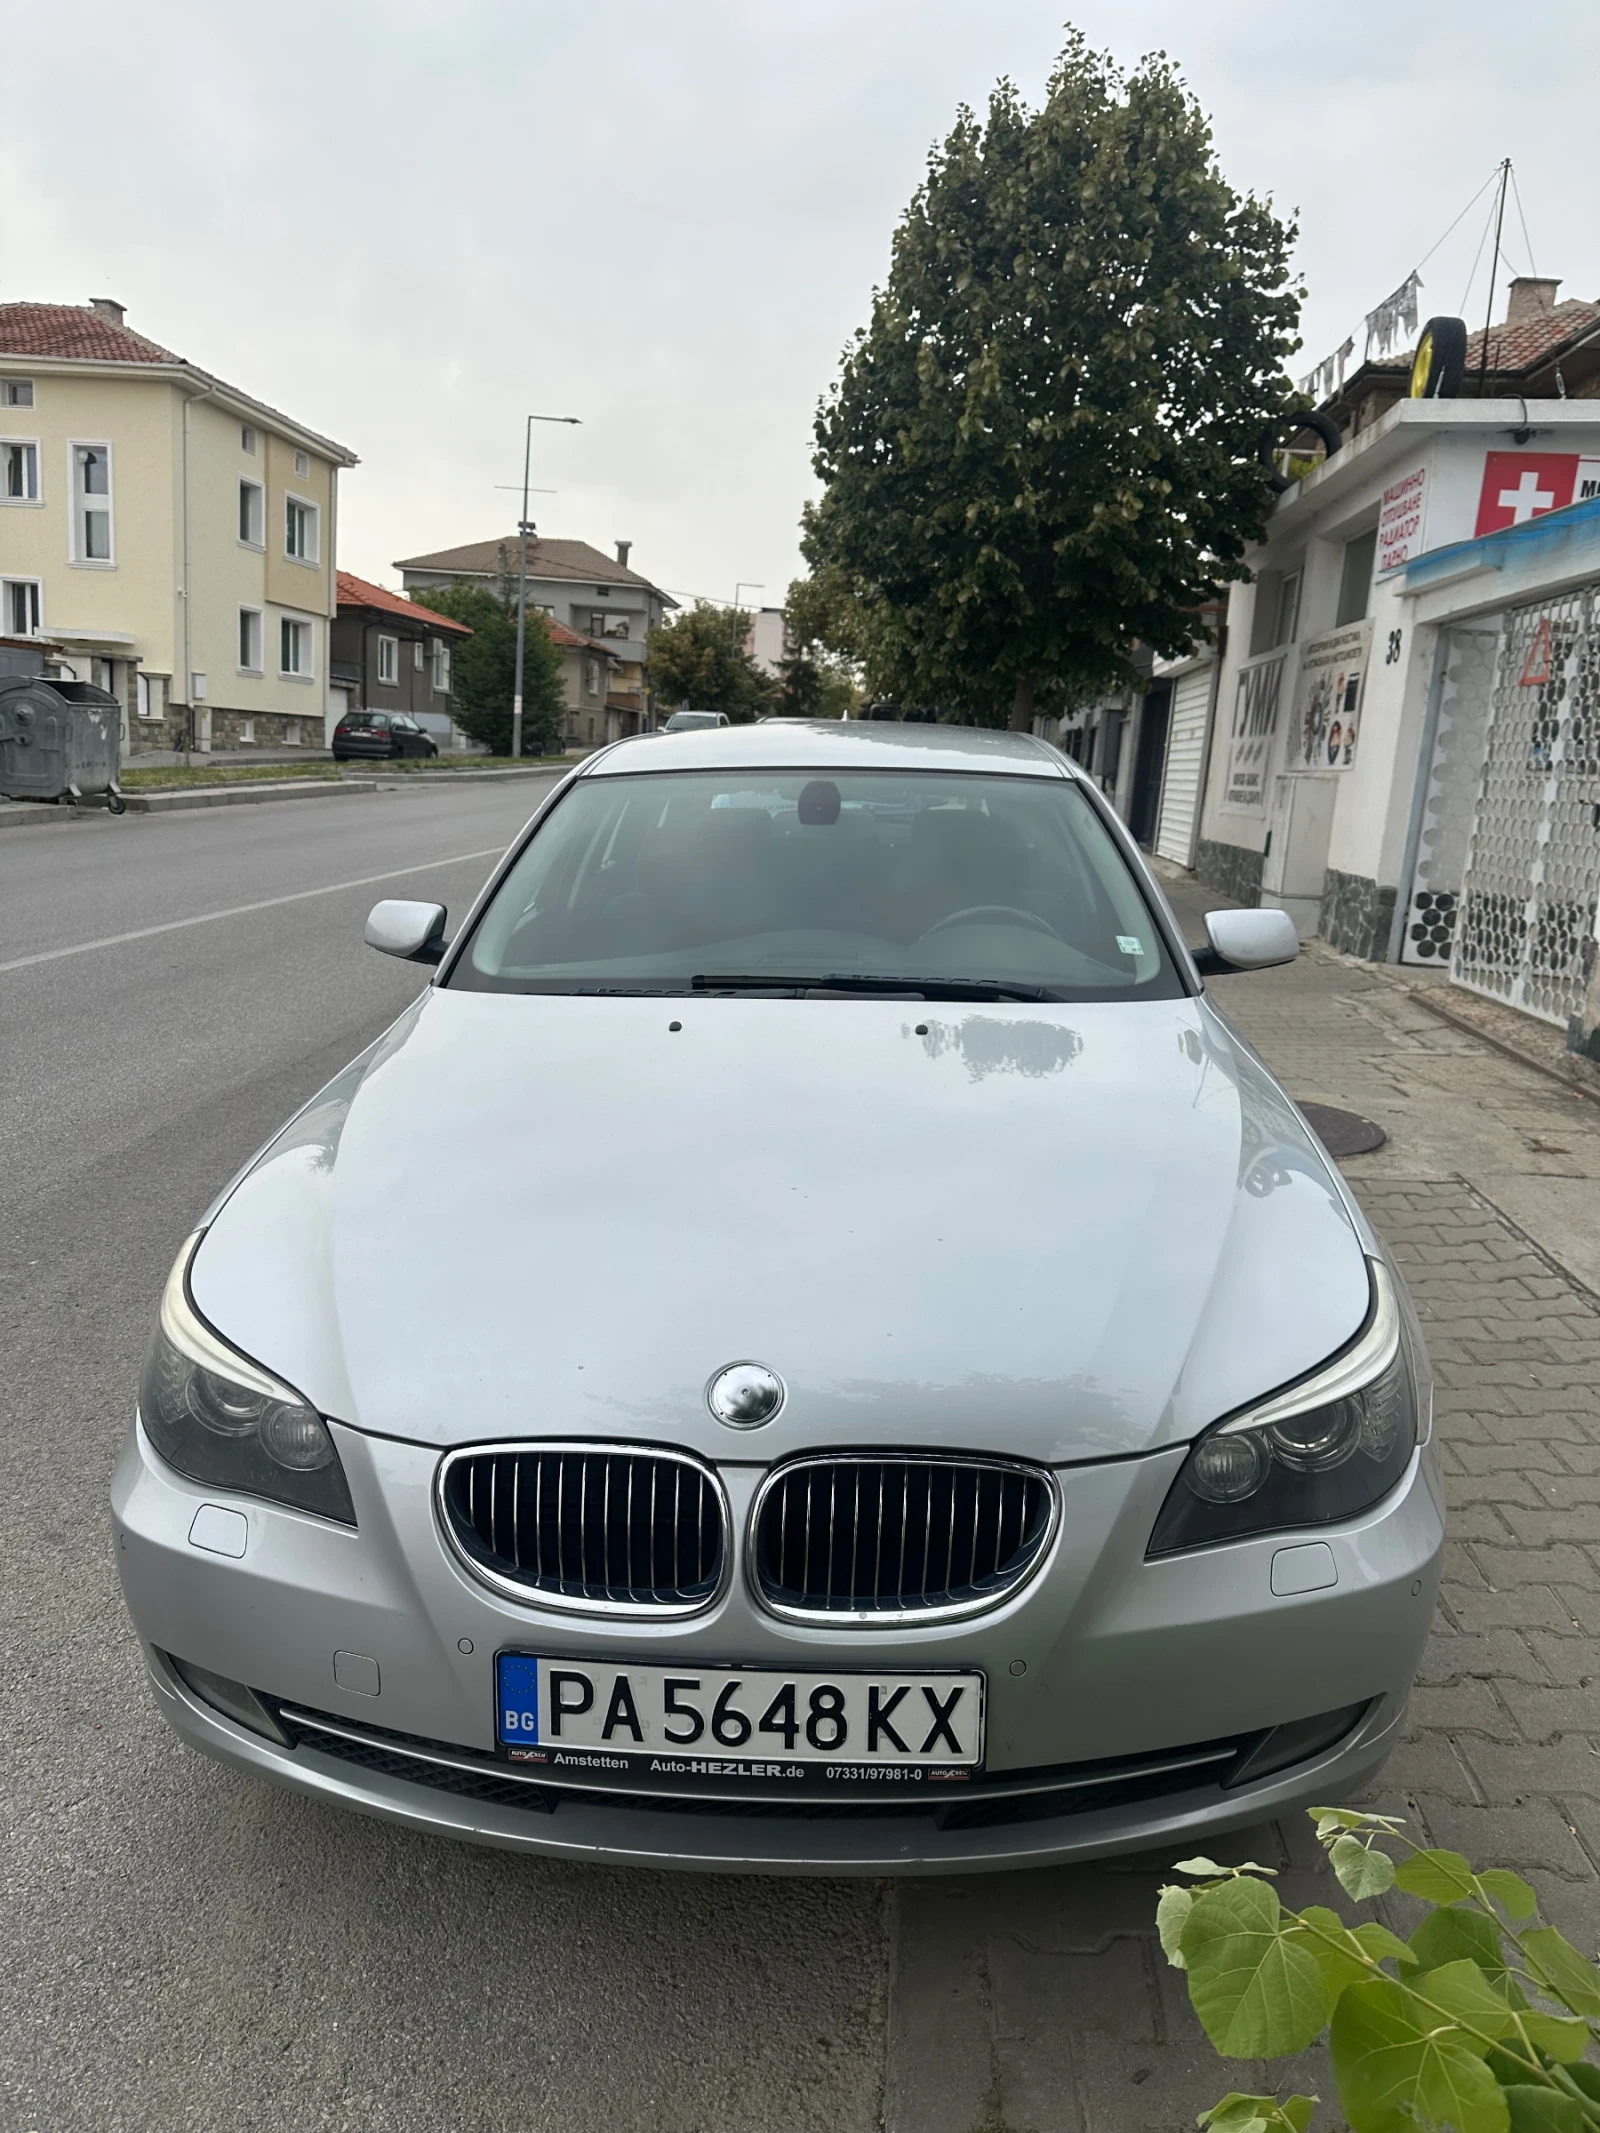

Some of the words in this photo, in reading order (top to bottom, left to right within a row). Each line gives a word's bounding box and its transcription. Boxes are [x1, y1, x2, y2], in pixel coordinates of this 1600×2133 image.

[1386, 628, 1402, 665] 38
[1232, 659, 1284, 738] ГУМИ
[505, 1710, 534, 1731] BG
[550, 1669, 645, 1742] PA
[663, 1678, 848, 1750] 5648
[867, 1685, 965, 1754] KX
[554, 1753, 629, 1769] Amstetten
[650, 1759, 805, 1778] Auto-HEZLER.de
[826, 1767, 922, 1780] 07331/97981-0
